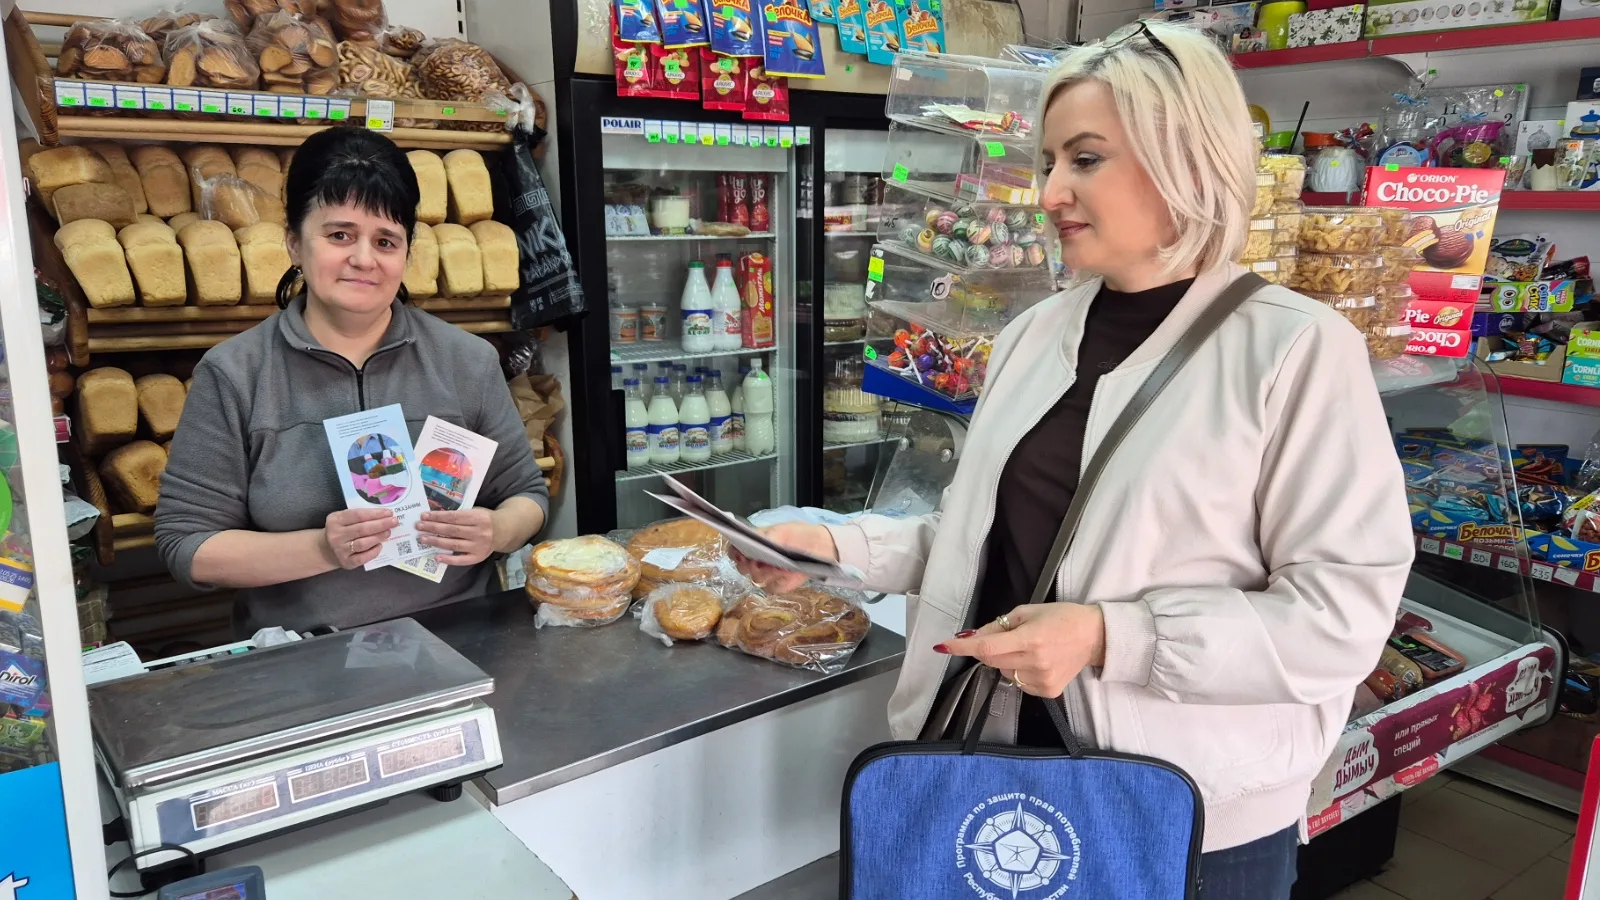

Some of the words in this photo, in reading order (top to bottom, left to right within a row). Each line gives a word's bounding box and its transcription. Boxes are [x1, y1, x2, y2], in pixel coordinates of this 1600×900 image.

[603, 119, 642, 129] POLAIR
[1419, 174, 1456, 183] ORION
[1454, 209, 1492, 232] Original
[0, 671, 37, 686] Dirol
[1395, 727, 1409, 741] или
[1411, 714, 1439, 733] пряных
[1344, 740, 1370, 767] ДЫМ
[1394, 736, 1421, 757] специй
[1334, 754, 1374, 792] ДЫМЫЧ
[212, 784, 238, 795] МАССА
[956, 813, 975, 869] Программа
[973, 802, 986, 815] по
[986, 792, 1026, 806] защите
[1029, 795, 1056, 814] прав
[1054, 810, 1082, 881] потребителей
